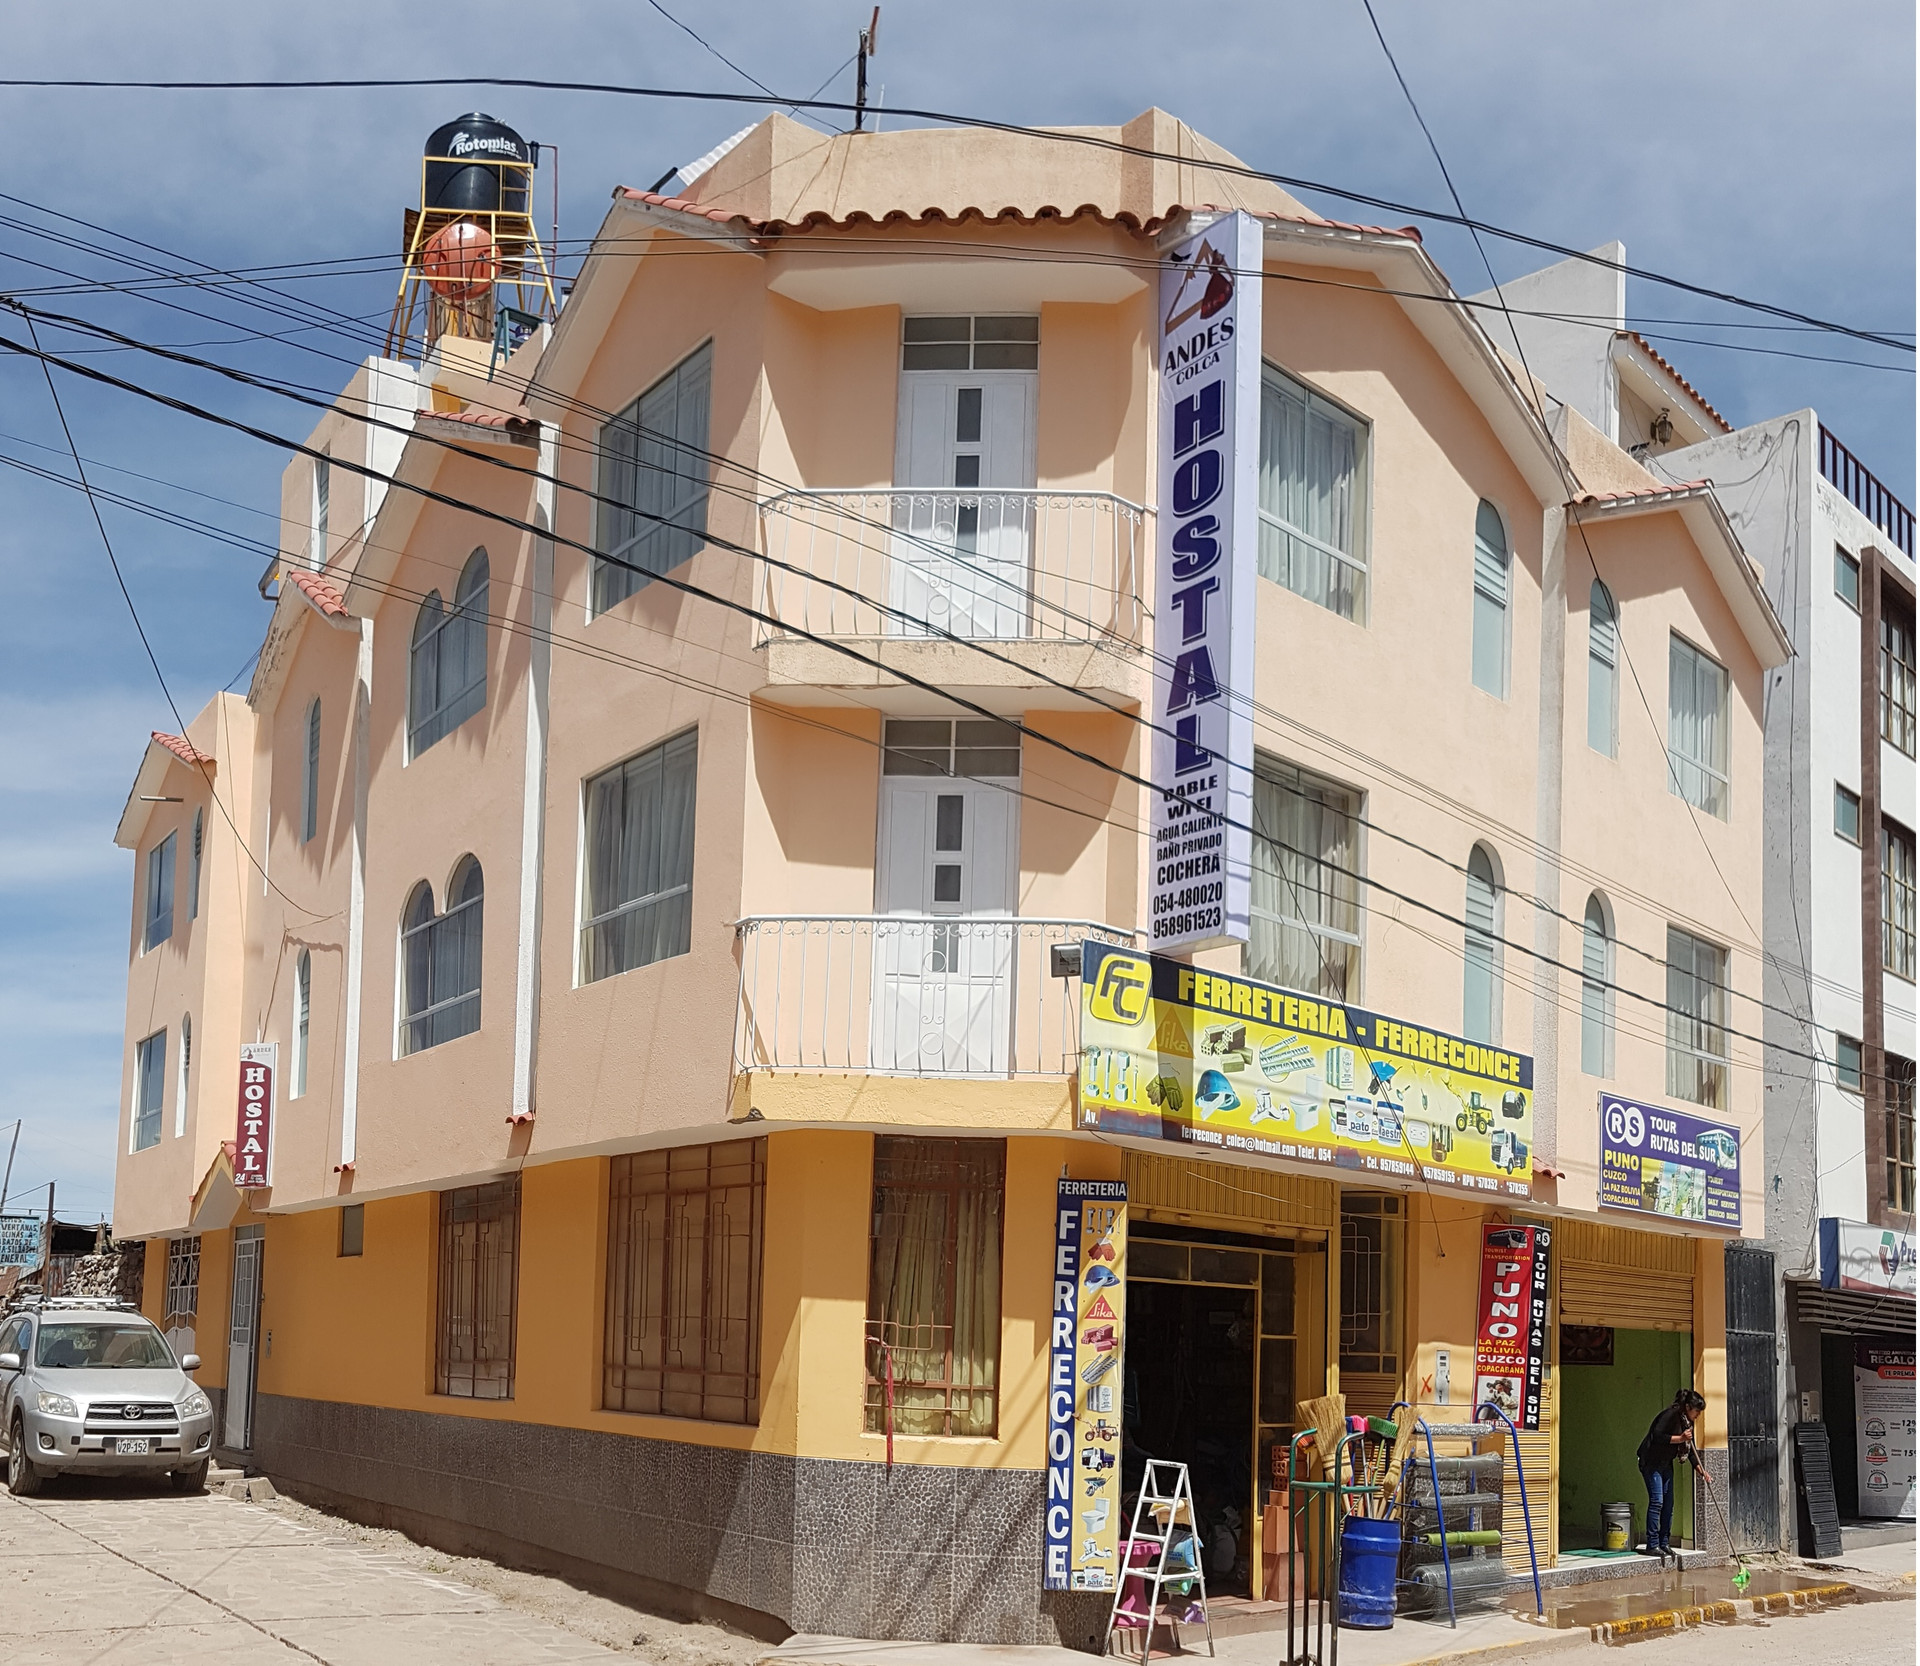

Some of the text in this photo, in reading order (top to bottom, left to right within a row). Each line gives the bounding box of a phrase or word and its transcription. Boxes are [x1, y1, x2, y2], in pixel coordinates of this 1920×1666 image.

[1164, 317, 1234, 376] ANDES
[1176, 351, 1220, 385] COLCA
[1166, 379, 1225, 777] HOSTAL
[1163, 774, 1218, 802] CABLE
[1157, 812, 1223, 843] AGUA CALIENTE
[1157, 833, 1222, 862] BAÑO PRIVADO
[1157, 853, 1220, 886] COCHERA
[1153, 881, 1223, 915] 054-480020
[1153, 906, 1221, 939] 958961523
[1158, 1020, 1189, 1053] Sika
[1178, 969, 1347, 1039] FERRETERIA
[1375, 1019, 1520, 1081] FERRECONCE
[242, 1068, 265, 1171] HOSTAL
[1084, 1109, 1099, 1124] Av.
[1350, 1121, 1369, 1132] pato
[1650, 1116, 1677, 1134] TOUR
[1318, 1148, 1331, 1161] 054
[1366, 1156, 1378, 1170] Cel.
[1604, 1149, 1639, 1171] PUNO
[1650, 1134, 1716, 1164] RUTAS DEL SUR
[235, 1173, 245, 1182] 24
[1603, 1169, 1627, 1181] CUZCO
[1058, 1181, 1127, 1197] FERRETERIA
[1603, 1182, 1640, 1196] LA PAZ BOLIVIA
[1603, 1193, 1639, 1206] COPACABANA
[1089, 1302, 1113, 1318] Sika
[1488, 1261, 1521, 1338] PUNO
[1478, 1346, 1522, 1355] BOLIVIA
[1495, 1339, 1516, 1347] PAZ
[1527, 1252, 1547, 1425] TOUR RUTAS DEL SUR
[1476, 1364, 1525, 1375] COPACABANA
[1477, 1354, 1526, 1365] CUZCO
[1047, 1209, 1079, 1579] FERRECONCE
[117, 1442, 148, 1453] V2P-152
